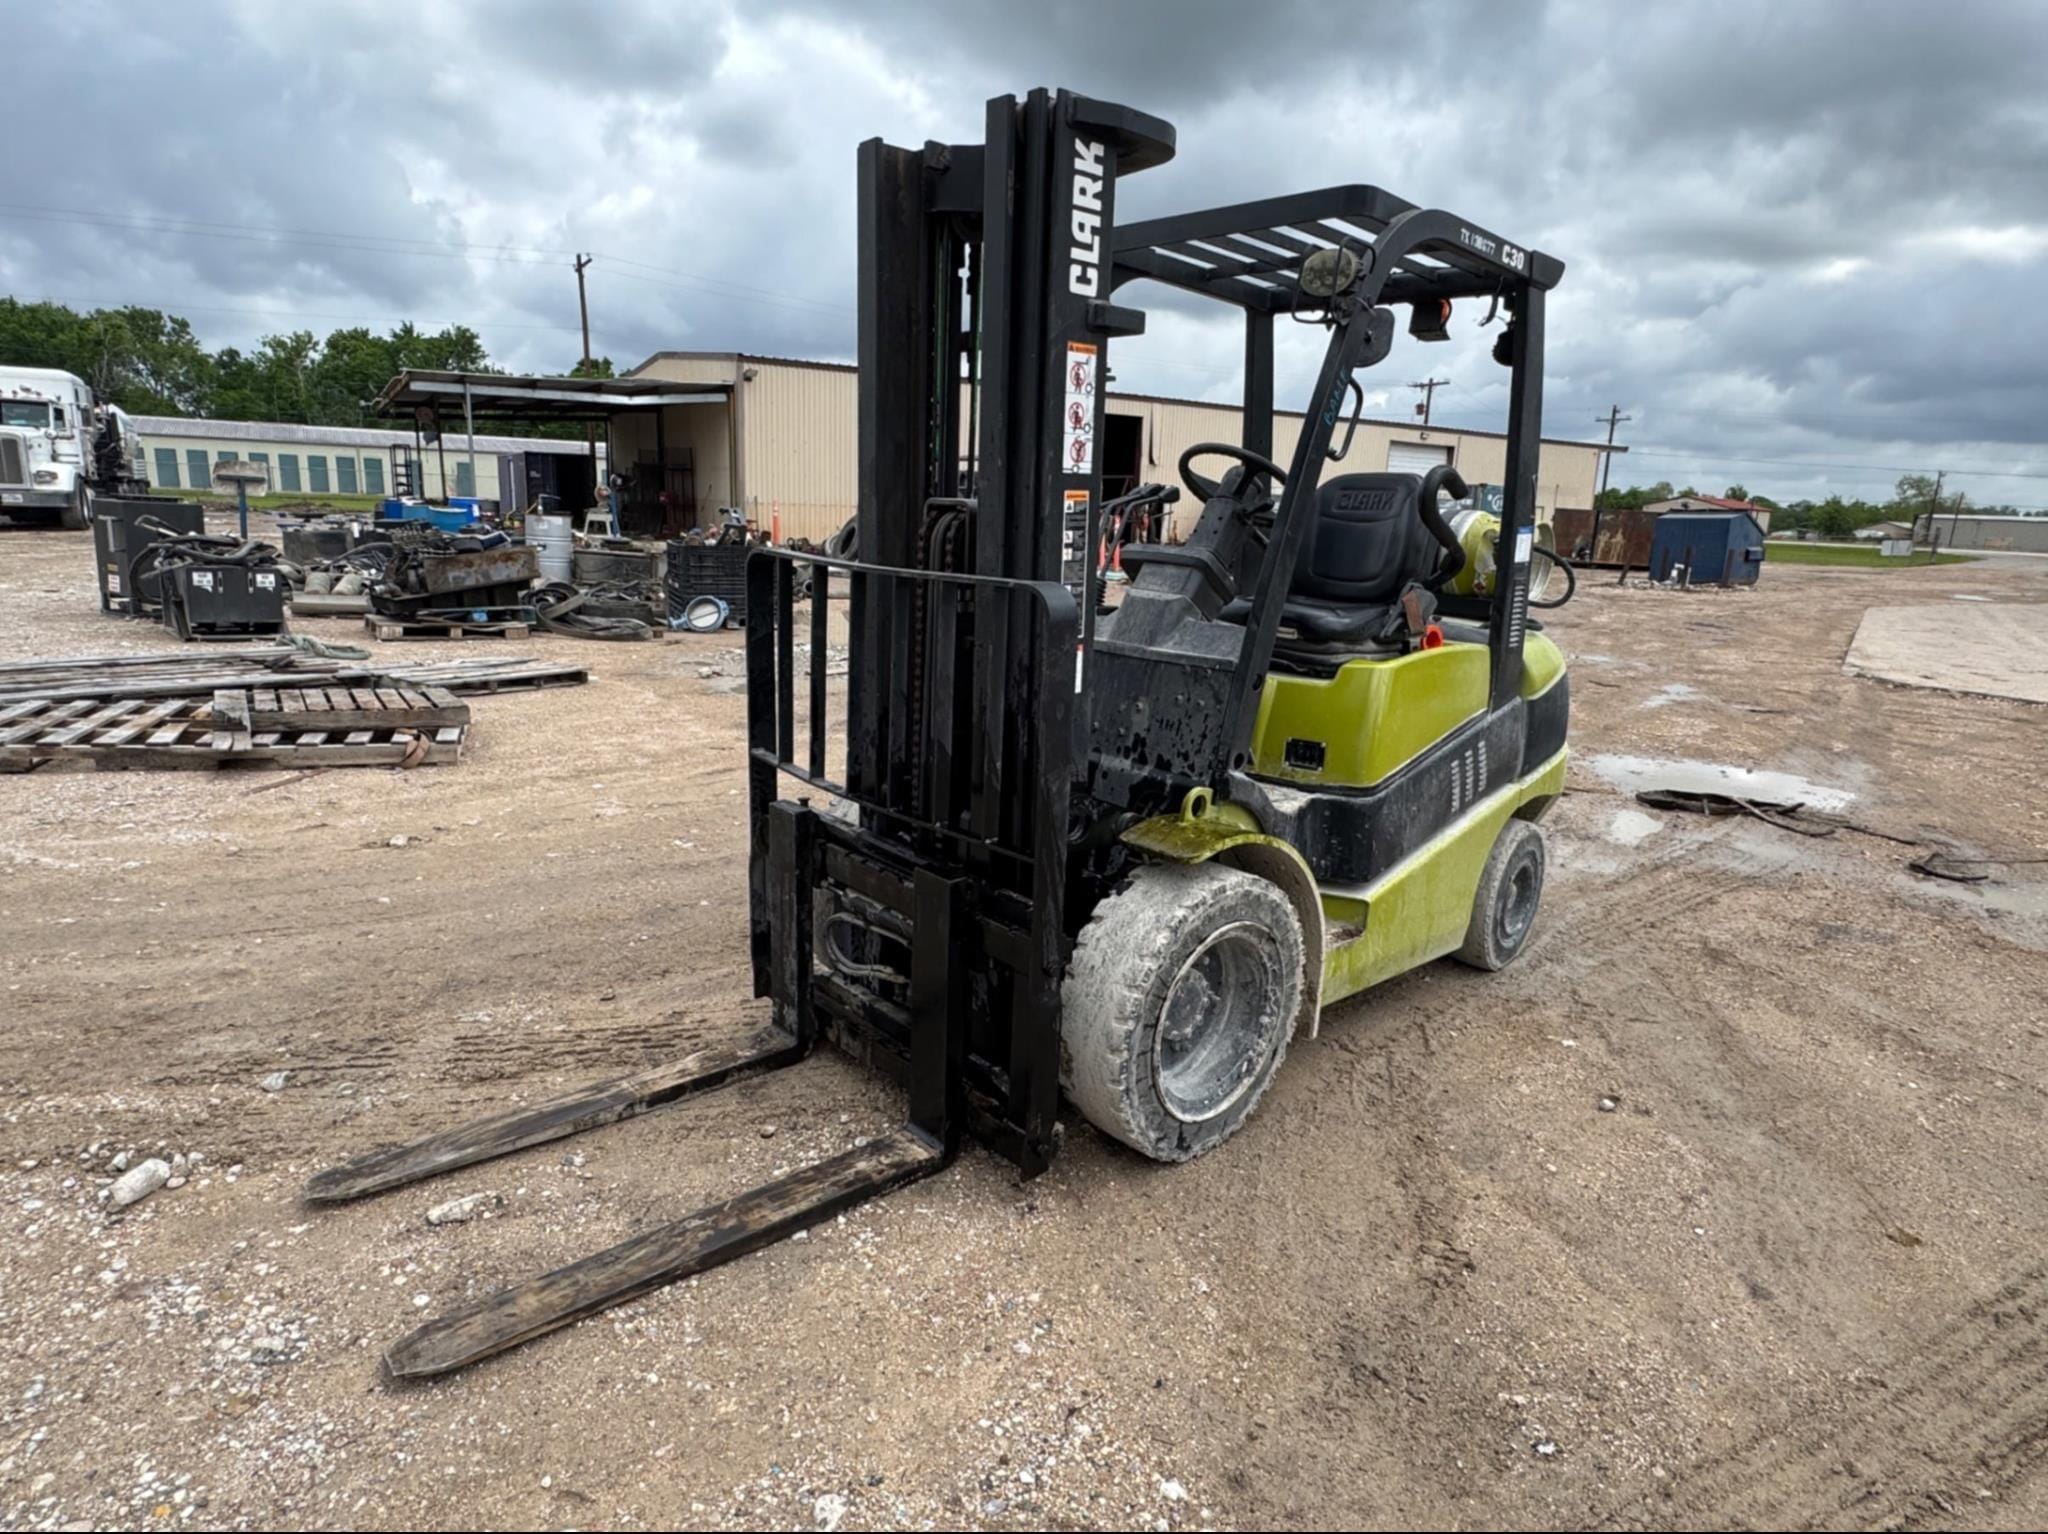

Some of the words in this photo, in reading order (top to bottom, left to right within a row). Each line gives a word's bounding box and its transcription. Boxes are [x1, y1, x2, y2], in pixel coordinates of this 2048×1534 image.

[1069, 137, 1105, 297] CLARK
[1502, 244, 1524, 270] C30
[1336, 492, 1395, 511] CLARK
